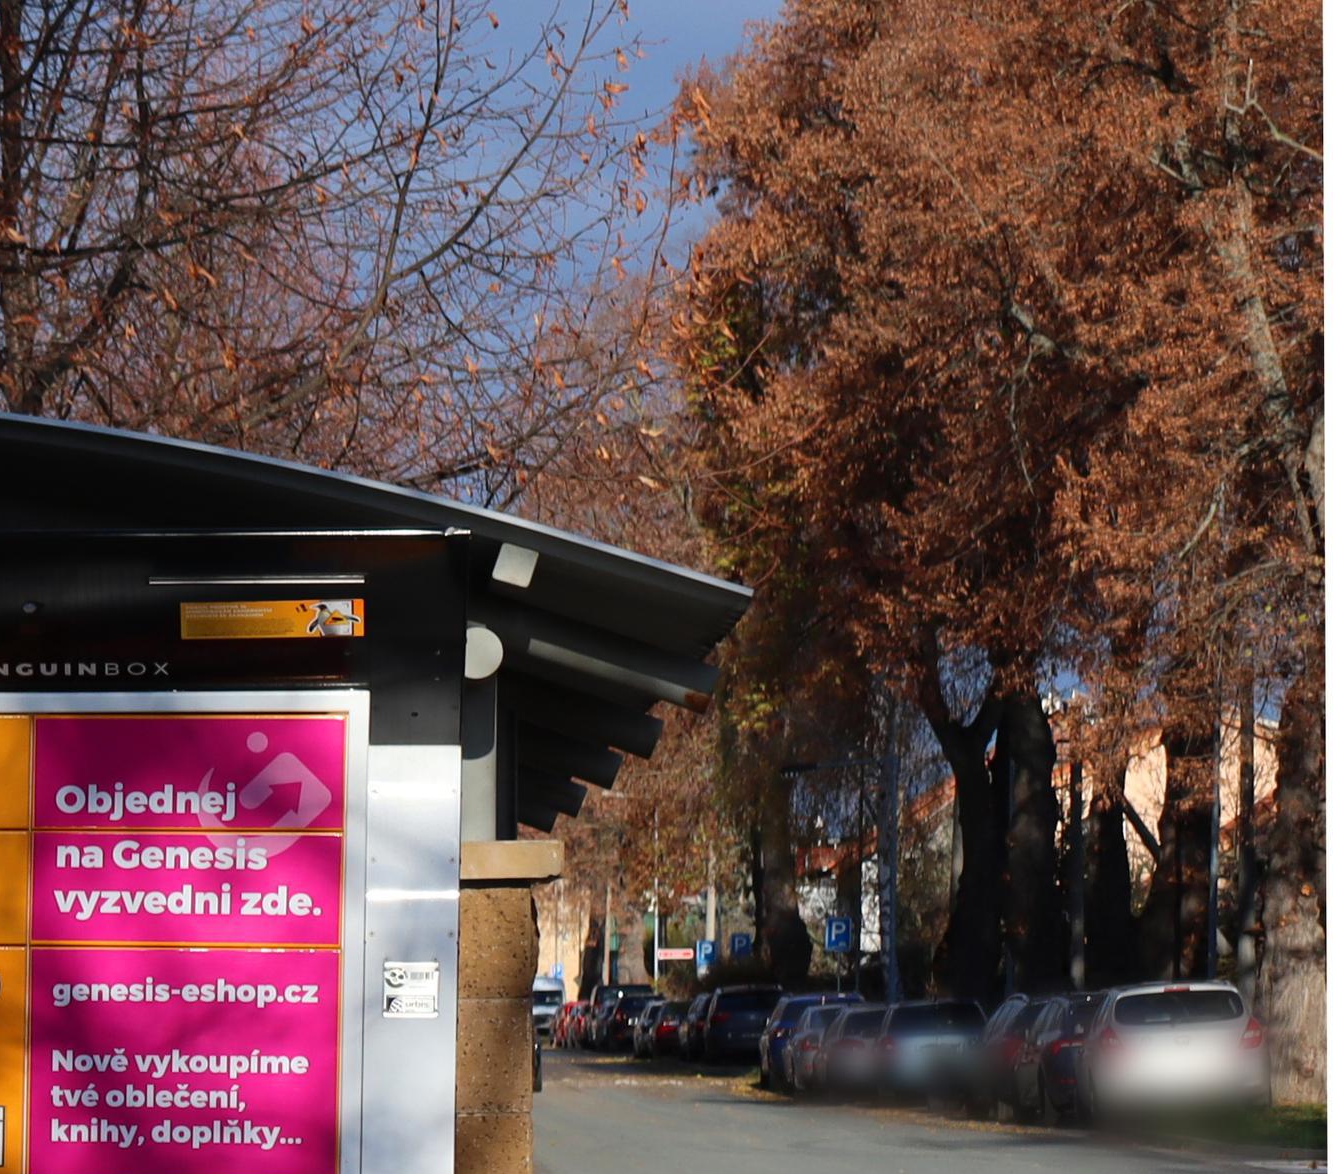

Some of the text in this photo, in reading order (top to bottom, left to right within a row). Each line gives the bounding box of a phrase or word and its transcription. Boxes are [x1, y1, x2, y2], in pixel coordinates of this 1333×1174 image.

[55, 784, 237, 822] Objednej
[56, 840, 267, 871] na Genesis
[54, 885, 322, 923] vyzvedni zde.
[734, 936, 748, 953] P
[831, 921, 846, 941] P
[701, 944, 713, 960] P
[51, 978, 319, 1009] genesis-eshop.cz
[51, 1048, 309, 1083] Nově vykoupíme
[51, 1083, 247, 1114] tvé oblečení,
[51, 1118, 302, 1150] knihy, doplňky...
